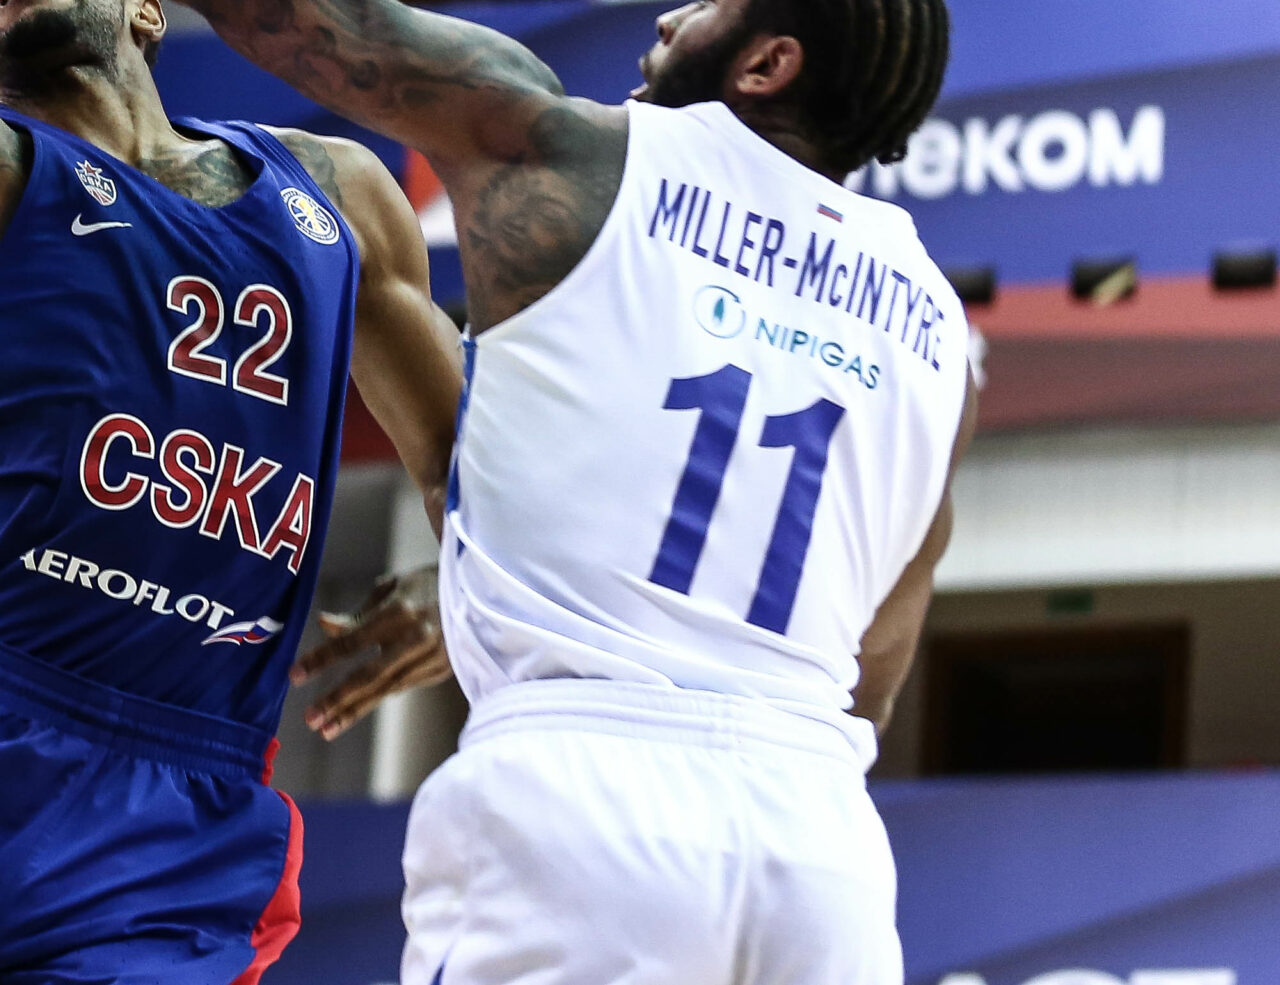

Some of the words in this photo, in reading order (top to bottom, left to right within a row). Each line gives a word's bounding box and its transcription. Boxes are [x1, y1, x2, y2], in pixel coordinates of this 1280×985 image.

[166, 275, 293, 406] 22
[649, 178, 945, 372] MILLER-McINTYRE
[754, 317, 881, 390] NIPIGAS
[79, 413, 314, 576] CSKA
[649, 363, 847, 635] 11
[20, 548, 234, 630] AEROFLOT
